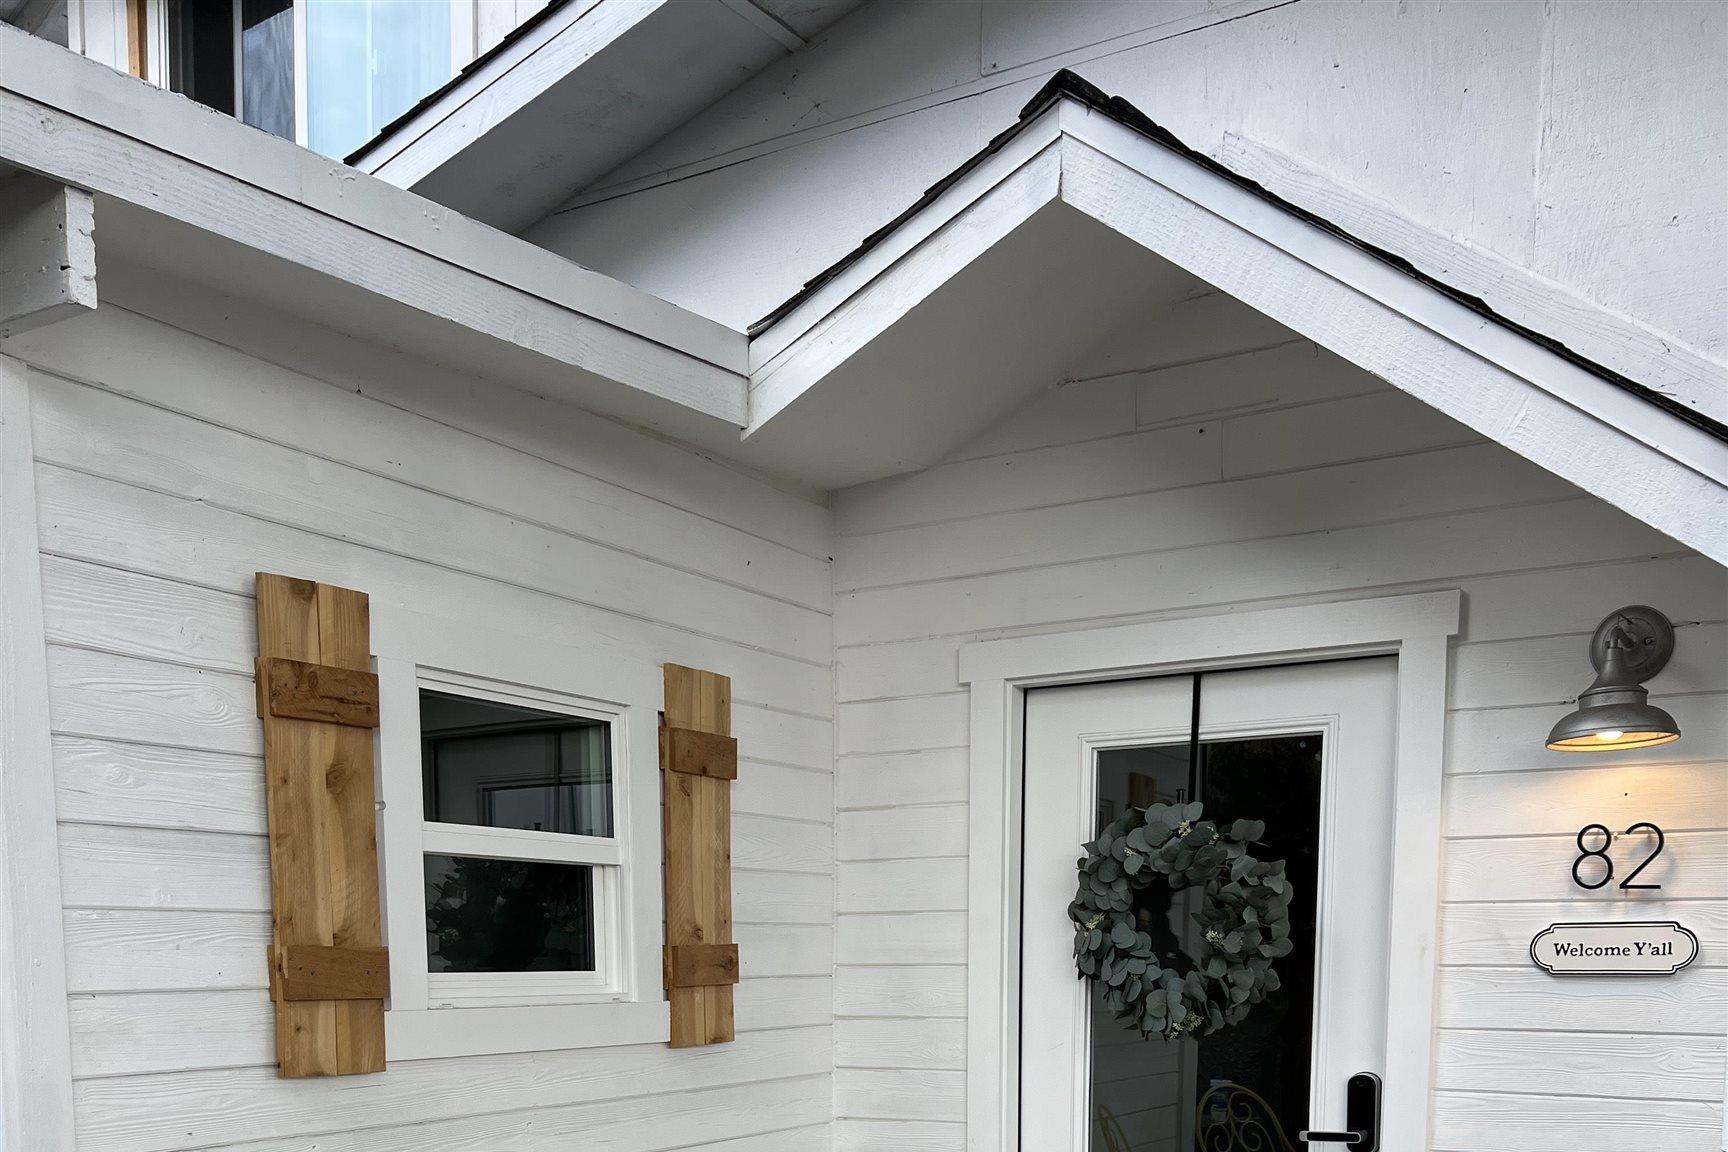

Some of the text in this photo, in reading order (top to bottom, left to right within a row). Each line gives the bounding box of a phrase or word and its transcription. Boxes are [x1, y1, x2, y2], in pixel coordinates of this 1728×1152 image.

[1572, 822, 1664, 889] 82
[1553, 941, 1673, 957] Welcome Y'all
